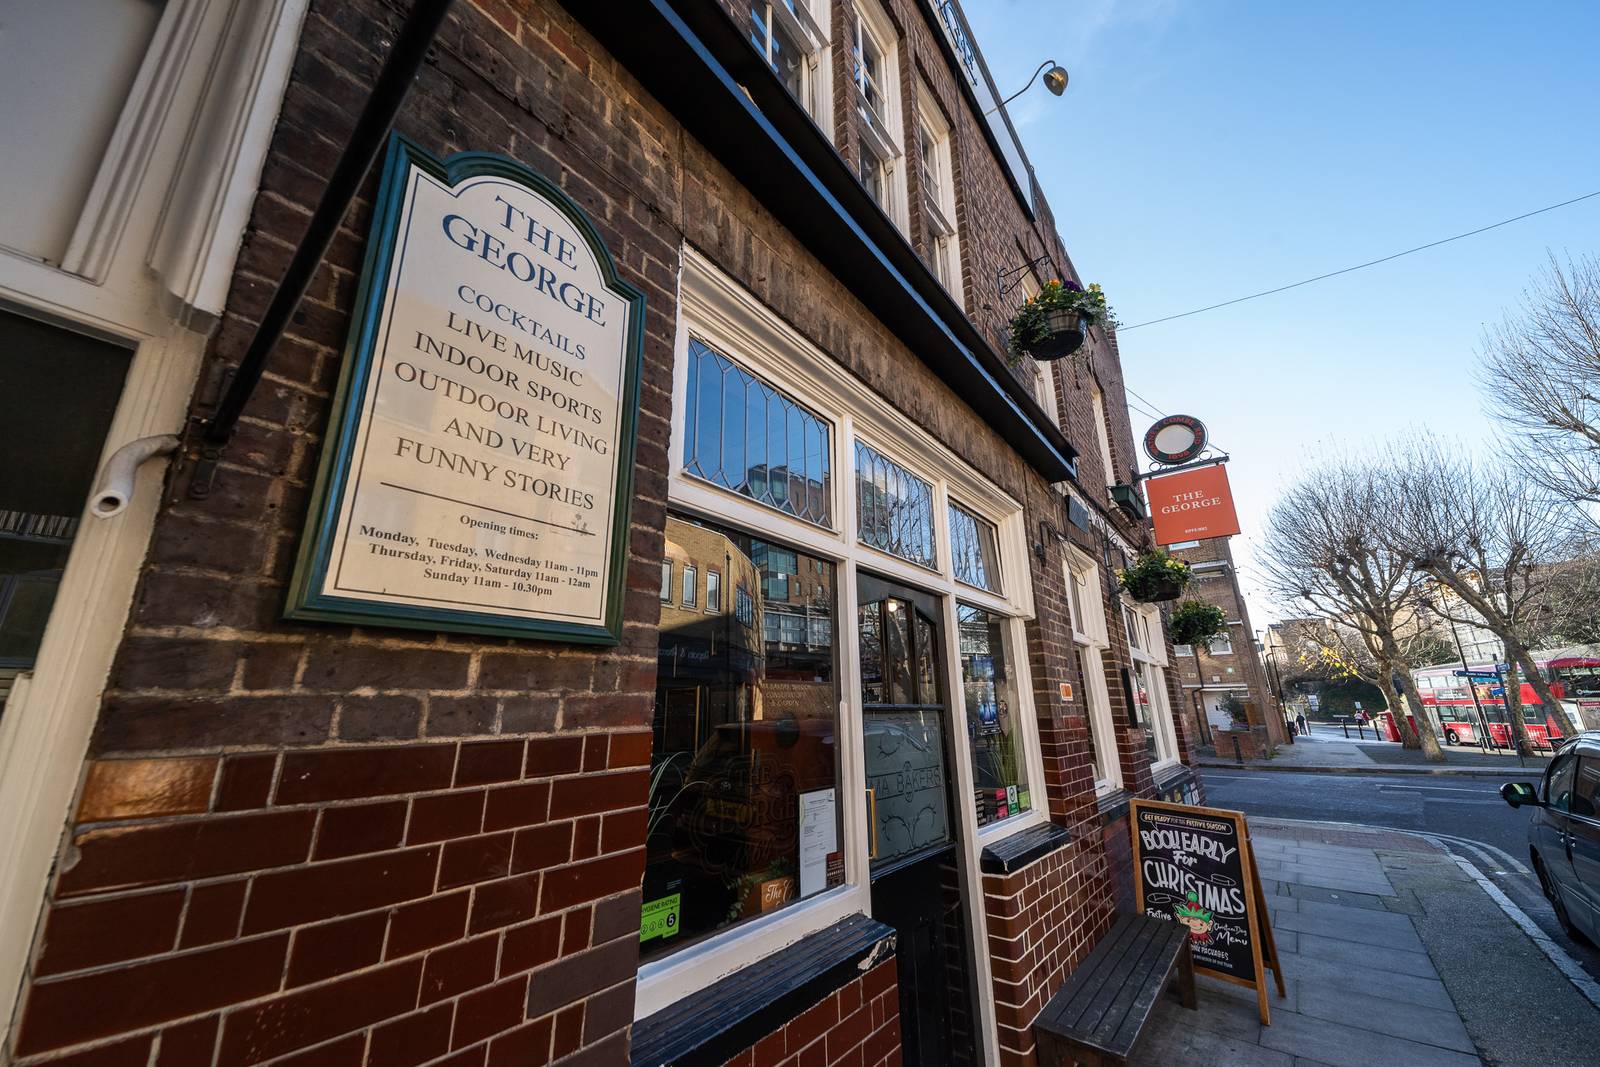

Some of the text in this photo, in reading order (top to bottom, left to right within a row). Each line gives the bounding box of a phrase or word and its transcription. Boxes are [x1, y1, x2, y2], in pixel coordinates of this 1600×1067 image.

[494, 195, 578, 271] THE
[442, 214, 606, 328] GEORGE
[445, 310, 584, 387] LIVE MUSIC
[457, 284, 586, 361] COCKTAILS
[413, 330, 603, 425] INDOOR SPORTS
[394, 362, 608, 455] OUTDOOR LIVING
[442, 417, 571, 472] AND VERY
[393, 436, 594, 510] FUNNY STORIES
[1172, 490, 1204, 502] THE
[459, 514, 539, 540] Opening times:
[1161, 497, 1221, 514] GEORGE
[359, 524, 420, 547] Monday,
[485, 548, 542, 568] Wednesday
[544, 560, 568, 572] 11am
[576, 566, 598, 578] 11pm
[484, 562, 532, 580] Saturday
[535, 571, 559, 583] 11am
[568, 577, 591, 588] 12am
[423, 568, 469, 585] Sunday
[474, 575, 501, 588] 11am
[512, 581, 553, 596] 10.30pm
[1181, 833, 1237, 864] EARLY
[1143, 860, 1246, 916] CHRISTMAS
[1216, 931, 1248, 947] Menu
